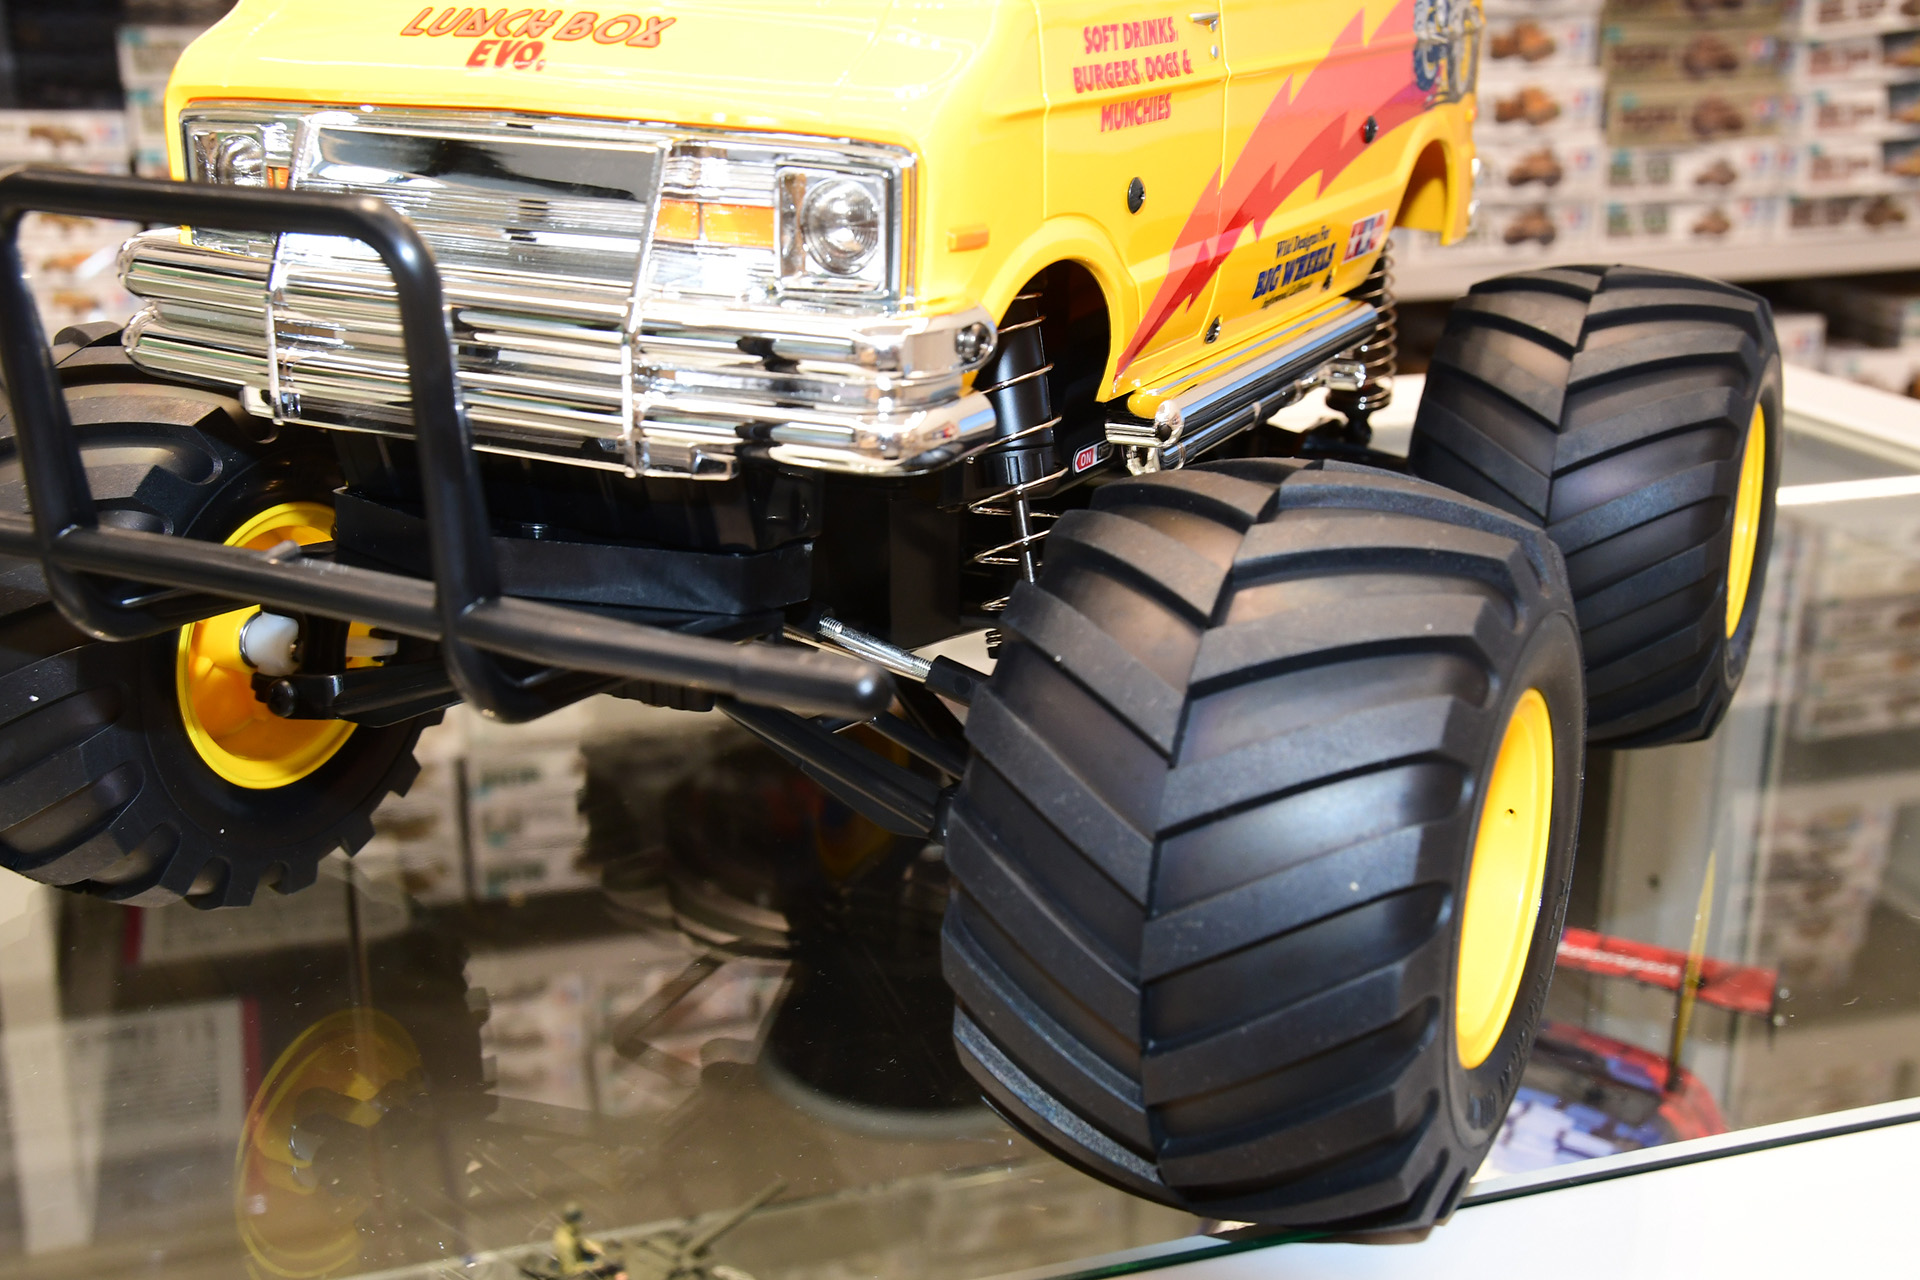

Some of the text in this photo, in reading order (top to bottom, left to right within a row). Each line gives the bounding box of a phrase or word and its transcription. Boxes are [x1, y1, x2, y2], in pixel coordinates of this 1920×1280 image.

[400, 7, 677, 48] LUNCH BOX
[1084, 16, 1179, 54] SOFT DRINKS,
[465, 39, 547, 72] EVO.
[1072, 48, 1194, 94] BURGERS, DOGS &
[1100, 92, 1172, 133] MUNCHIES
[1252, 264, 1282, 300] BIG
[1281, 242, 1337, 287] WHEELS
[1081, 450, 1092, 467] ON
